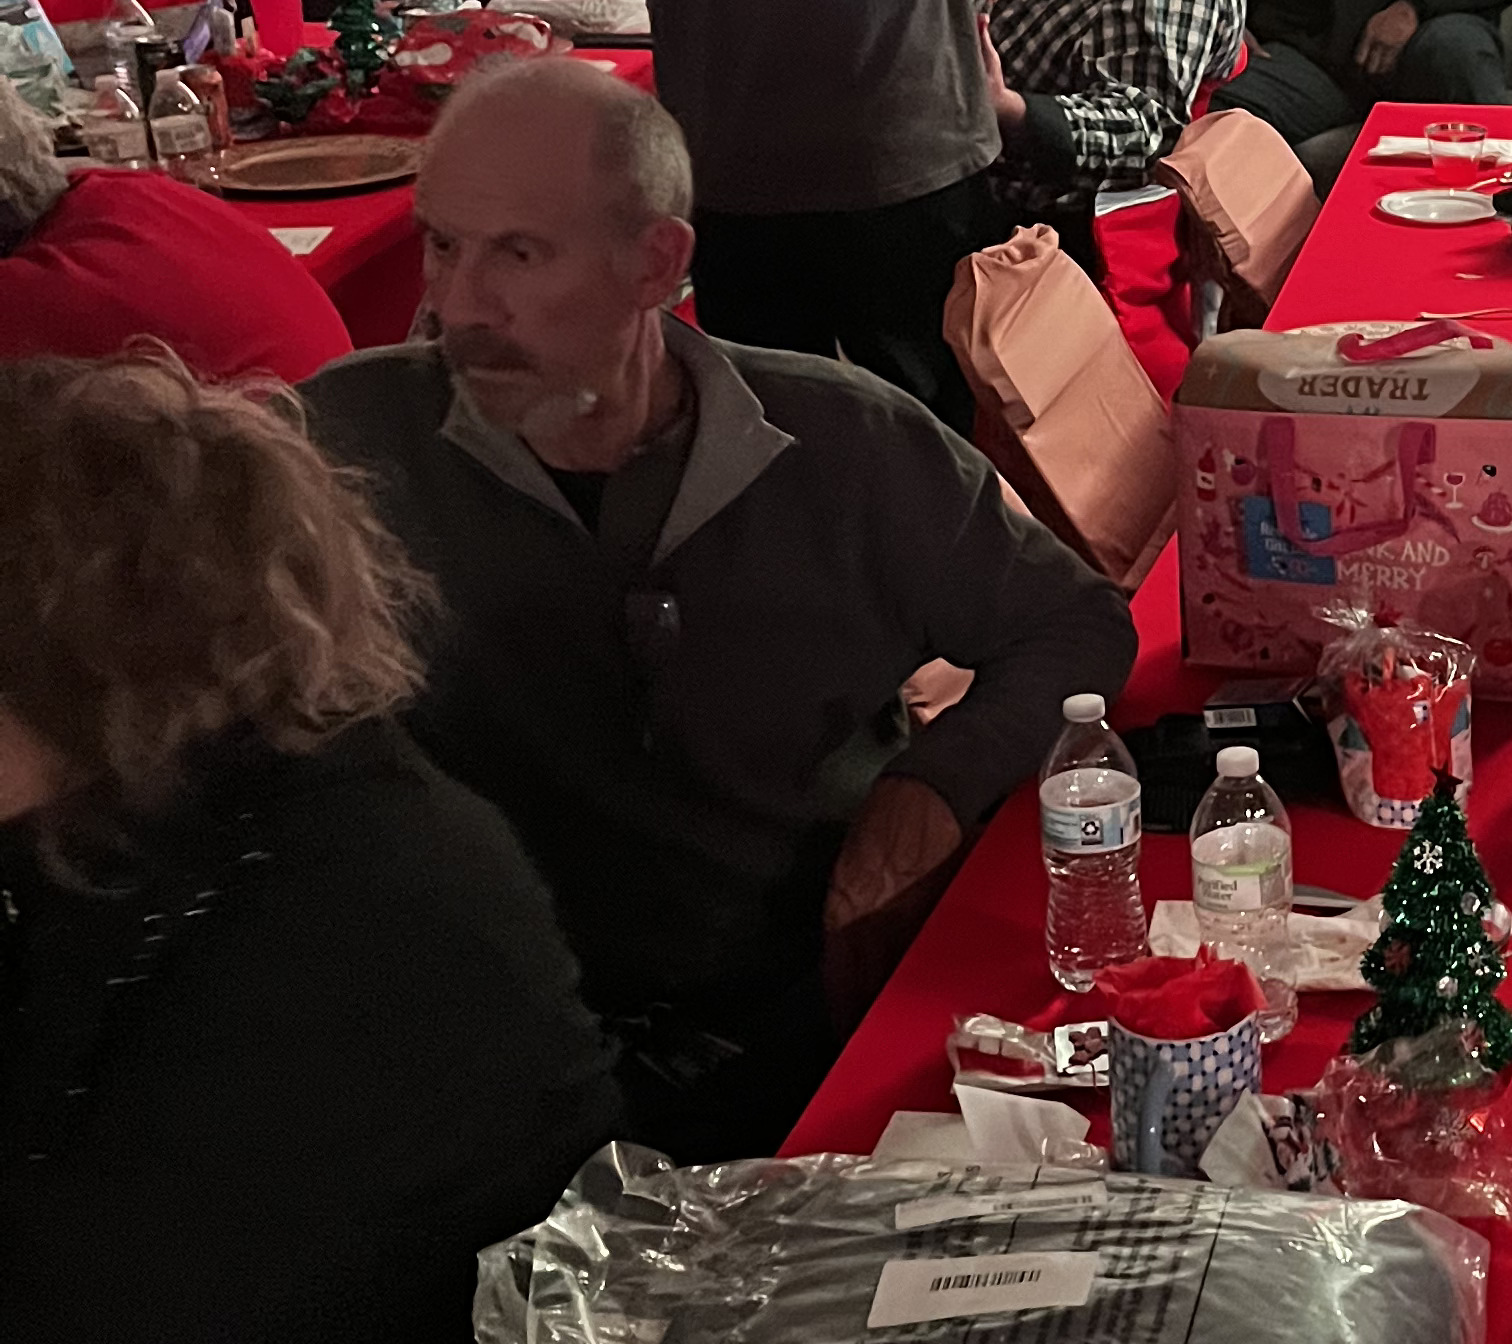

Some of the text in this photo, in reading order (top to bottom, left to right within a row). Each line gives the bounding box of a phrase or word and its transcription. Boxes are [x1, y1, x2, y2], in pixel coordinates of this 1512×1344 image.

[1297, 374, 1431, 401] TRADER
[1400, 540, 1451, 567] AND
[1336, 560, 1427, 592] MERRY
